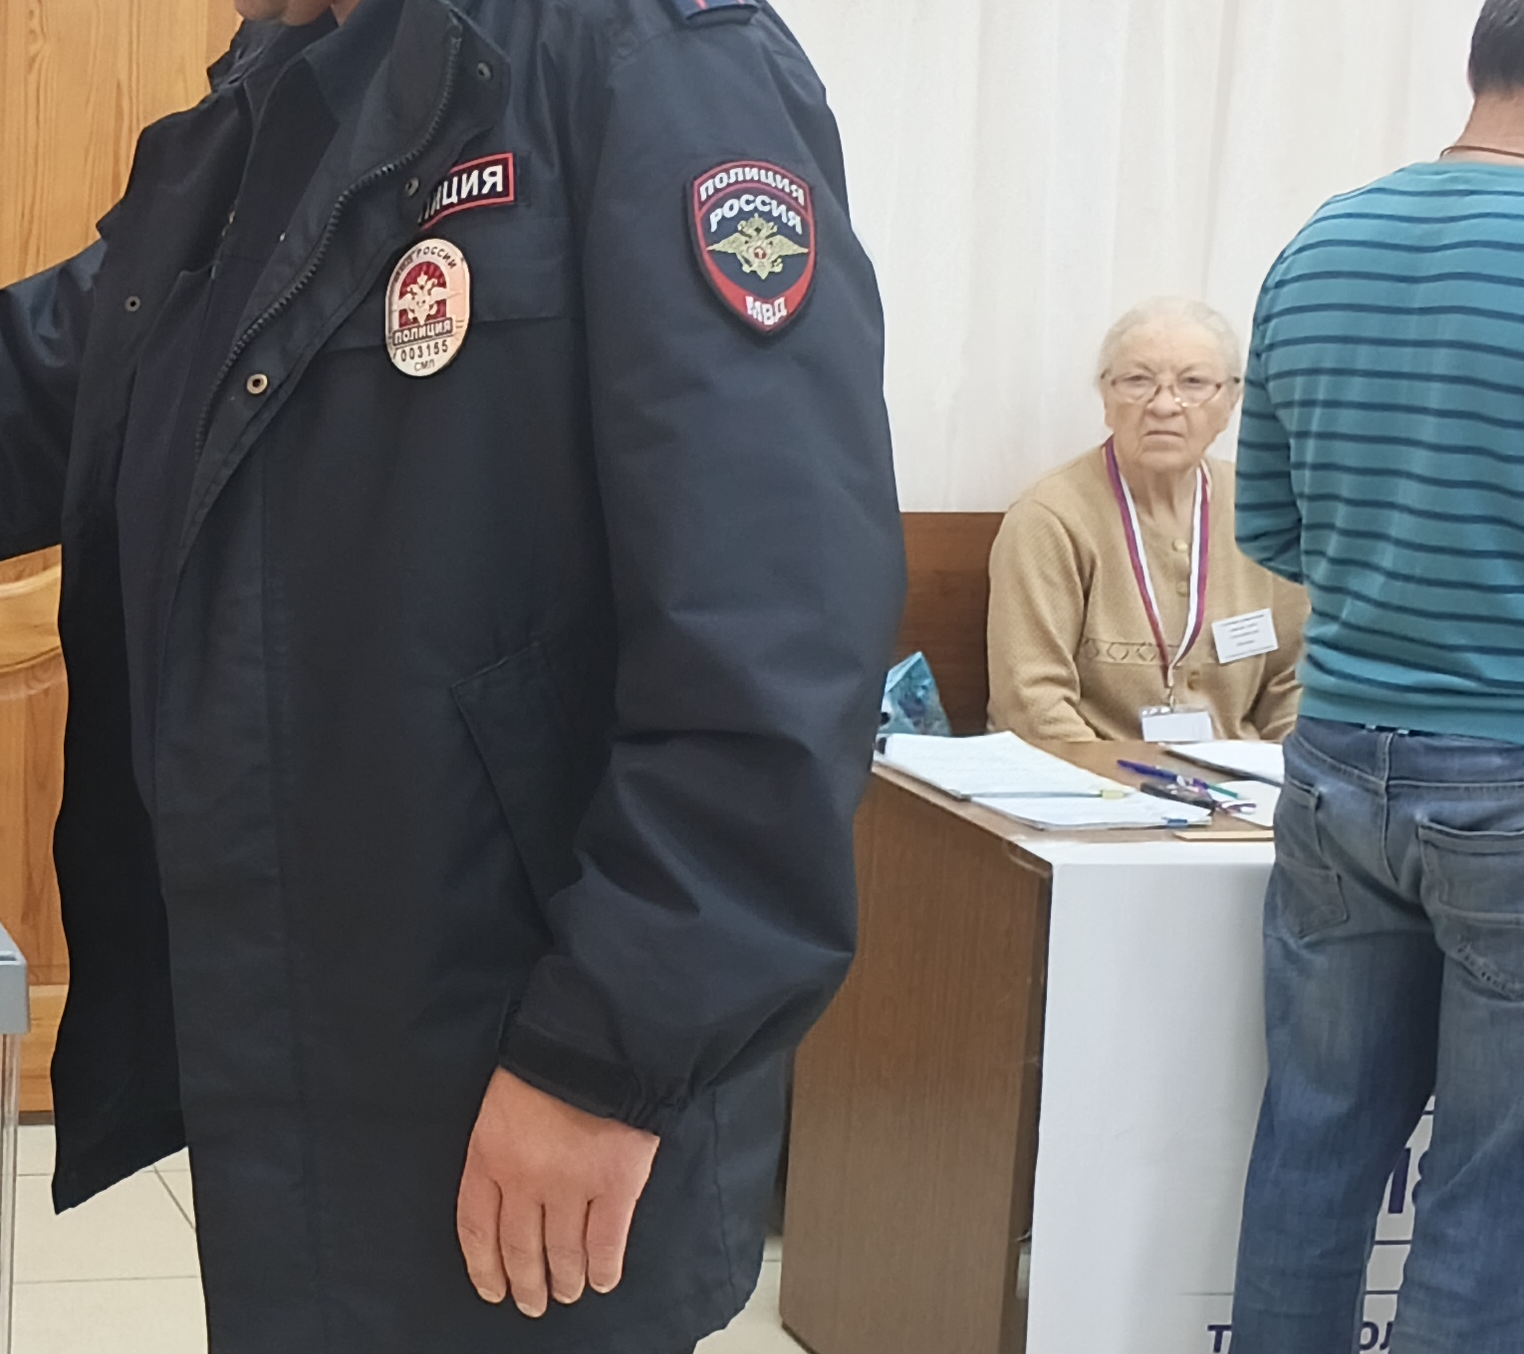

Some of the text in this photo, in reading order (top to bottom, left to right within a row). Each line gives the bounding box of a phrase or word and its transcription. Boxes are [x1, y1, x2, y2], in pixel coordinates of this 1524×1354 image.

[699, 167, 805, 206] ПОЛИЦИЯ
[709, 194, 803, 235] РОССИЯ
[745, 295, 788, 326] МВД
[394, 320, 452, 344] ПОЛИЦИЯ
